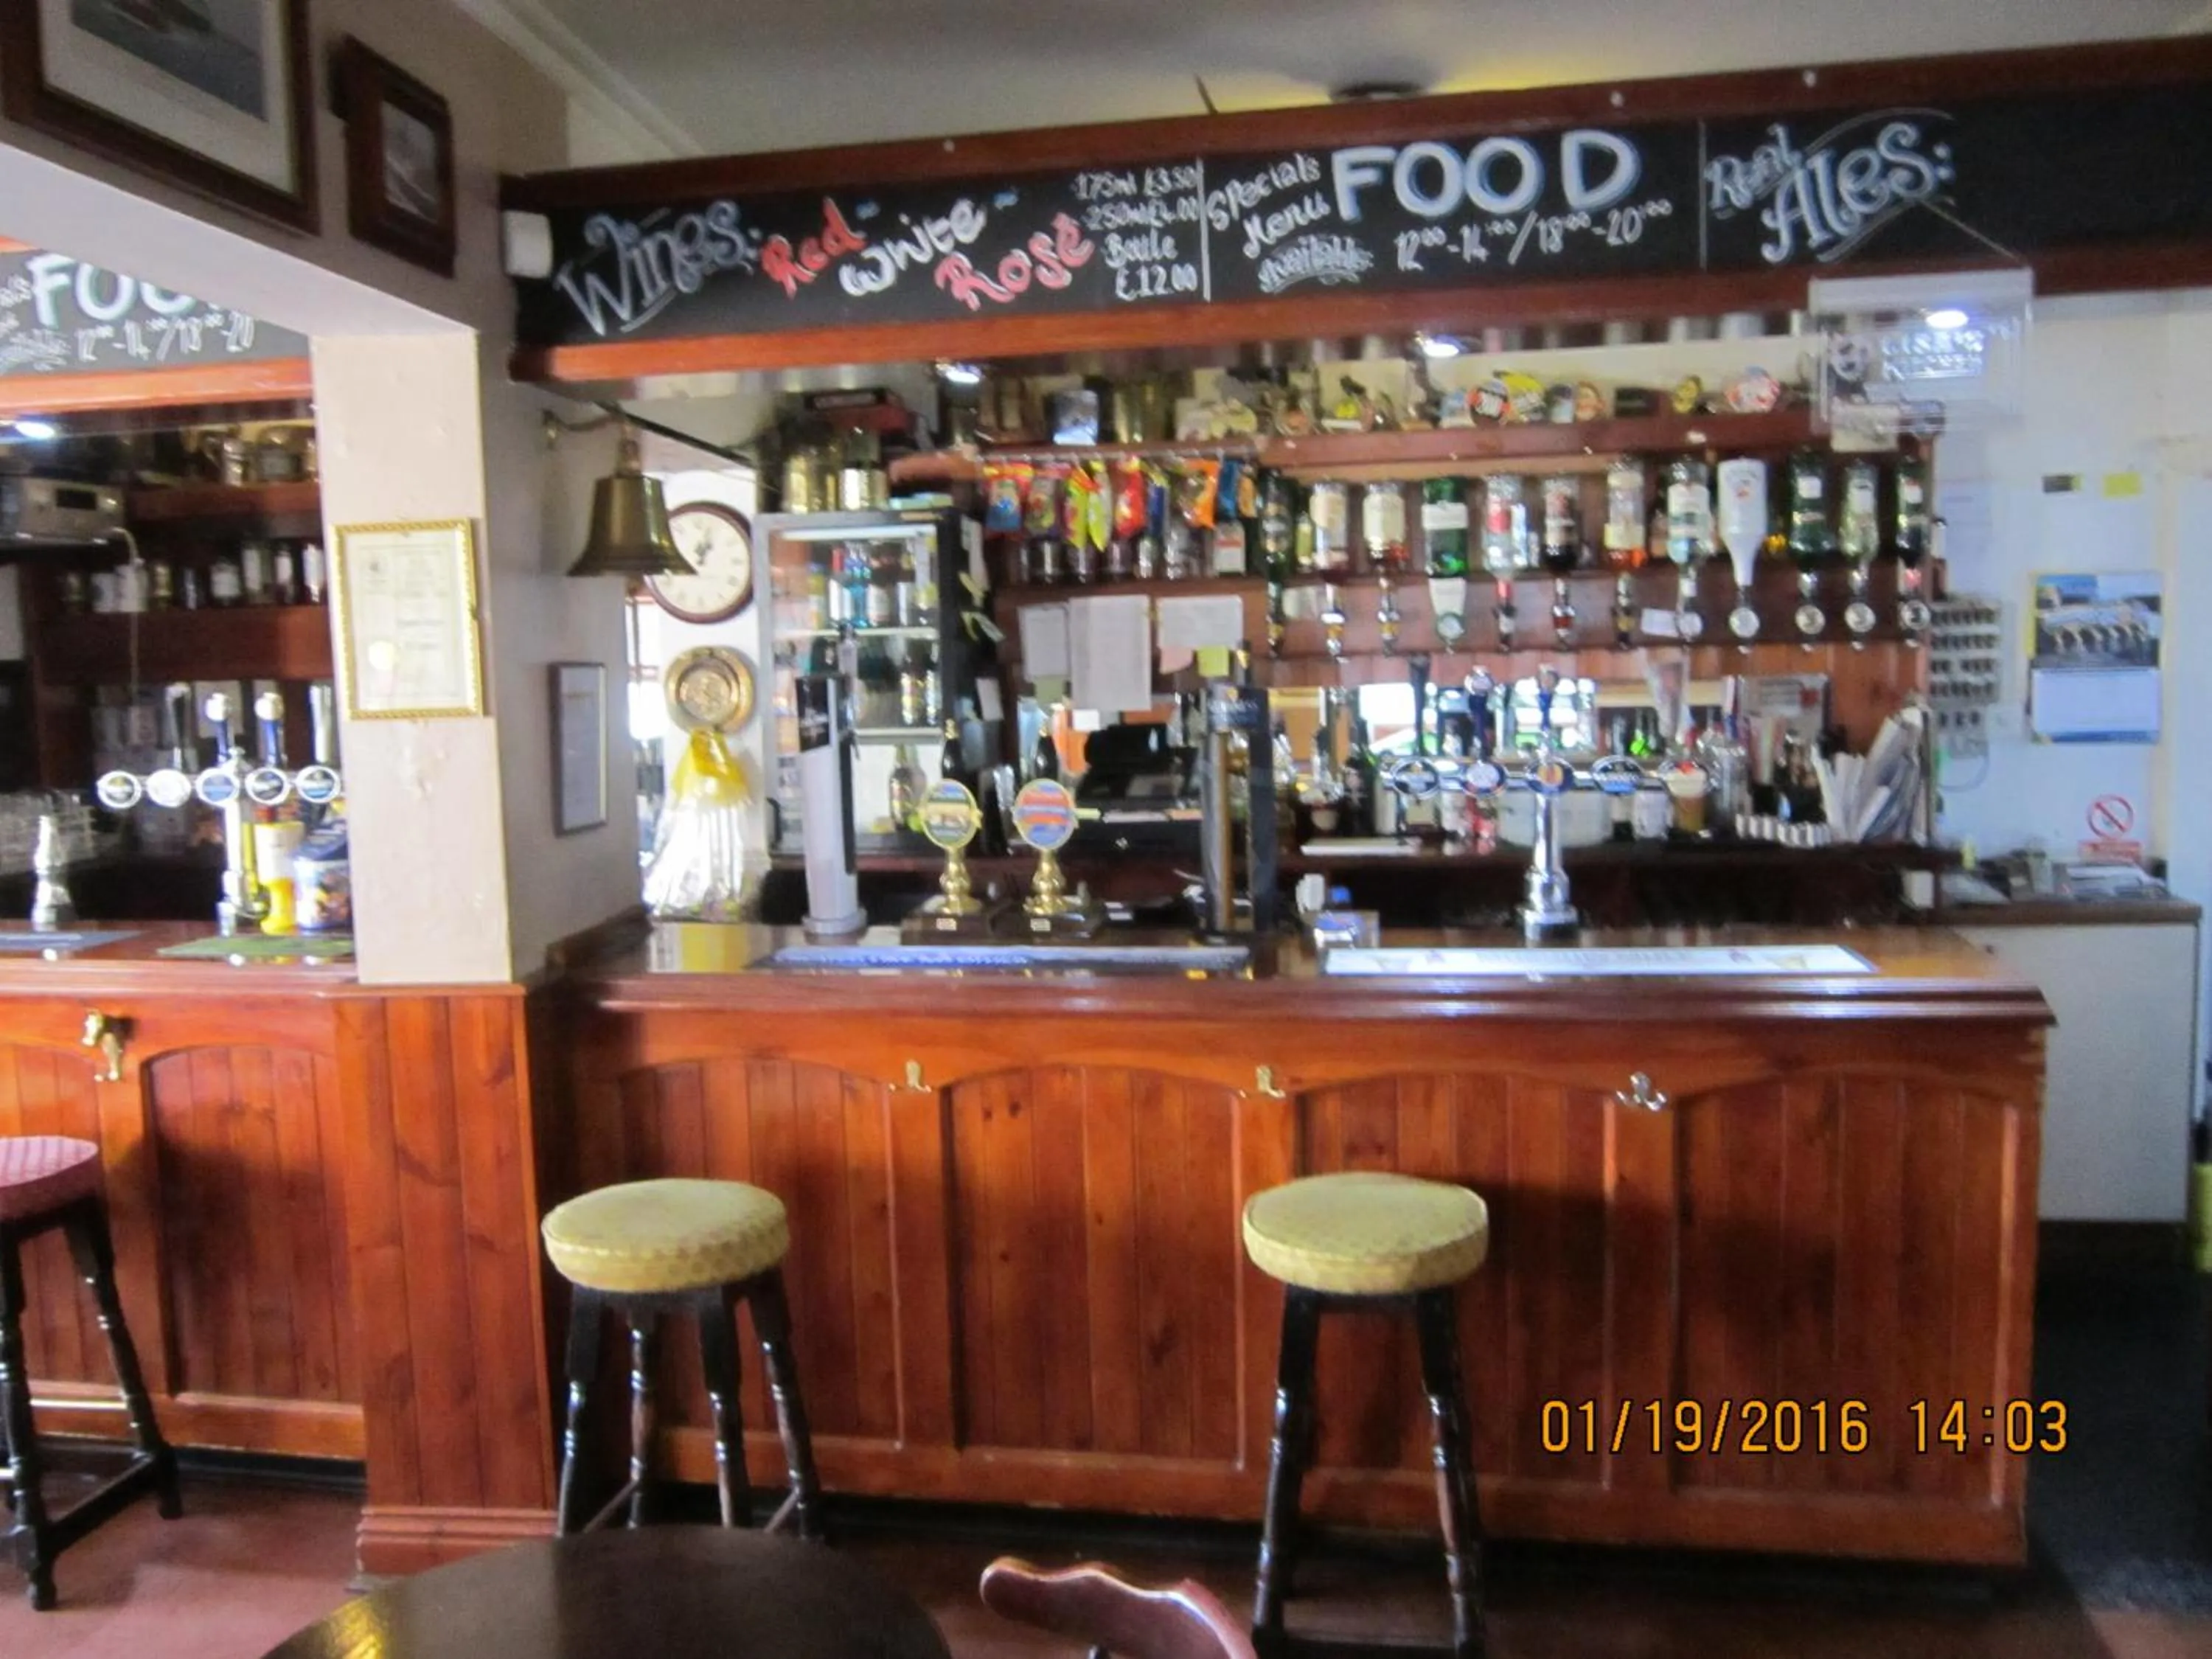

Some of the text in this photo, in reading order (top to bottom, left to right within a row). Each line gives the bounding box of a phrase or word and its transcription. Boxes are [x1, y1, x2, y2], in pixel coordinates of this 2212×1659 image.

[1330, 128, 1642, 220] FOOD
[25, 253, 197, 330] FO
[761, 196, 867, 300] Red
